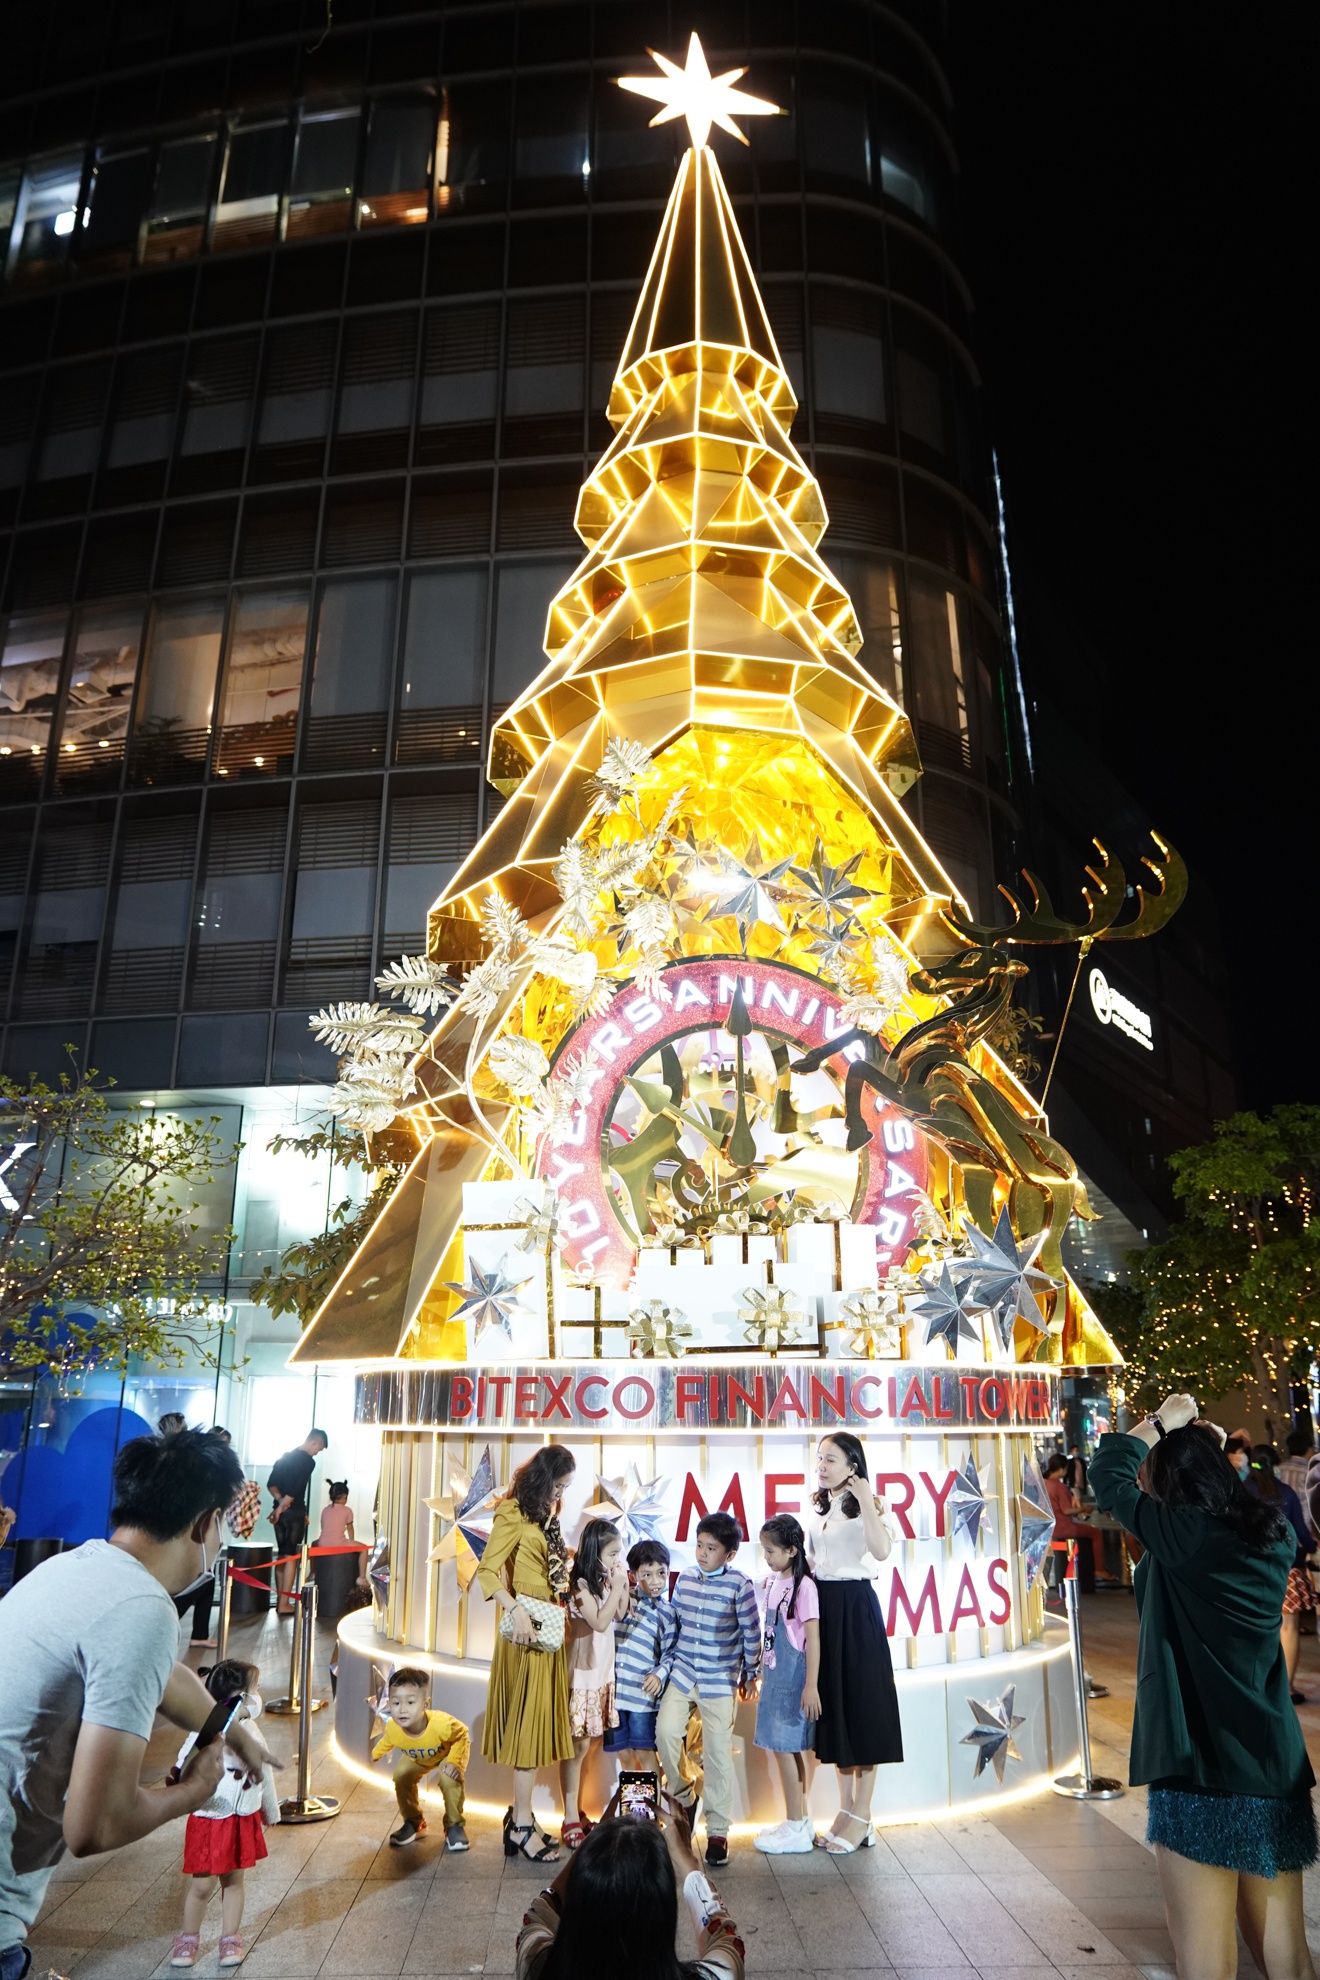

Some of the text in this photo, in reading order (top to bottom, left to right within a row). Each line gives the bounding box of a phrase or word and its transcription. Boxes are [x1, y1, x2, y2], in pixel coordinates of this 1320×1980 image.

[450, 1374, 1051, 1420] BITEXCO FINANCIAL TOWER
[674, 1471, 958, 1542] MERY
